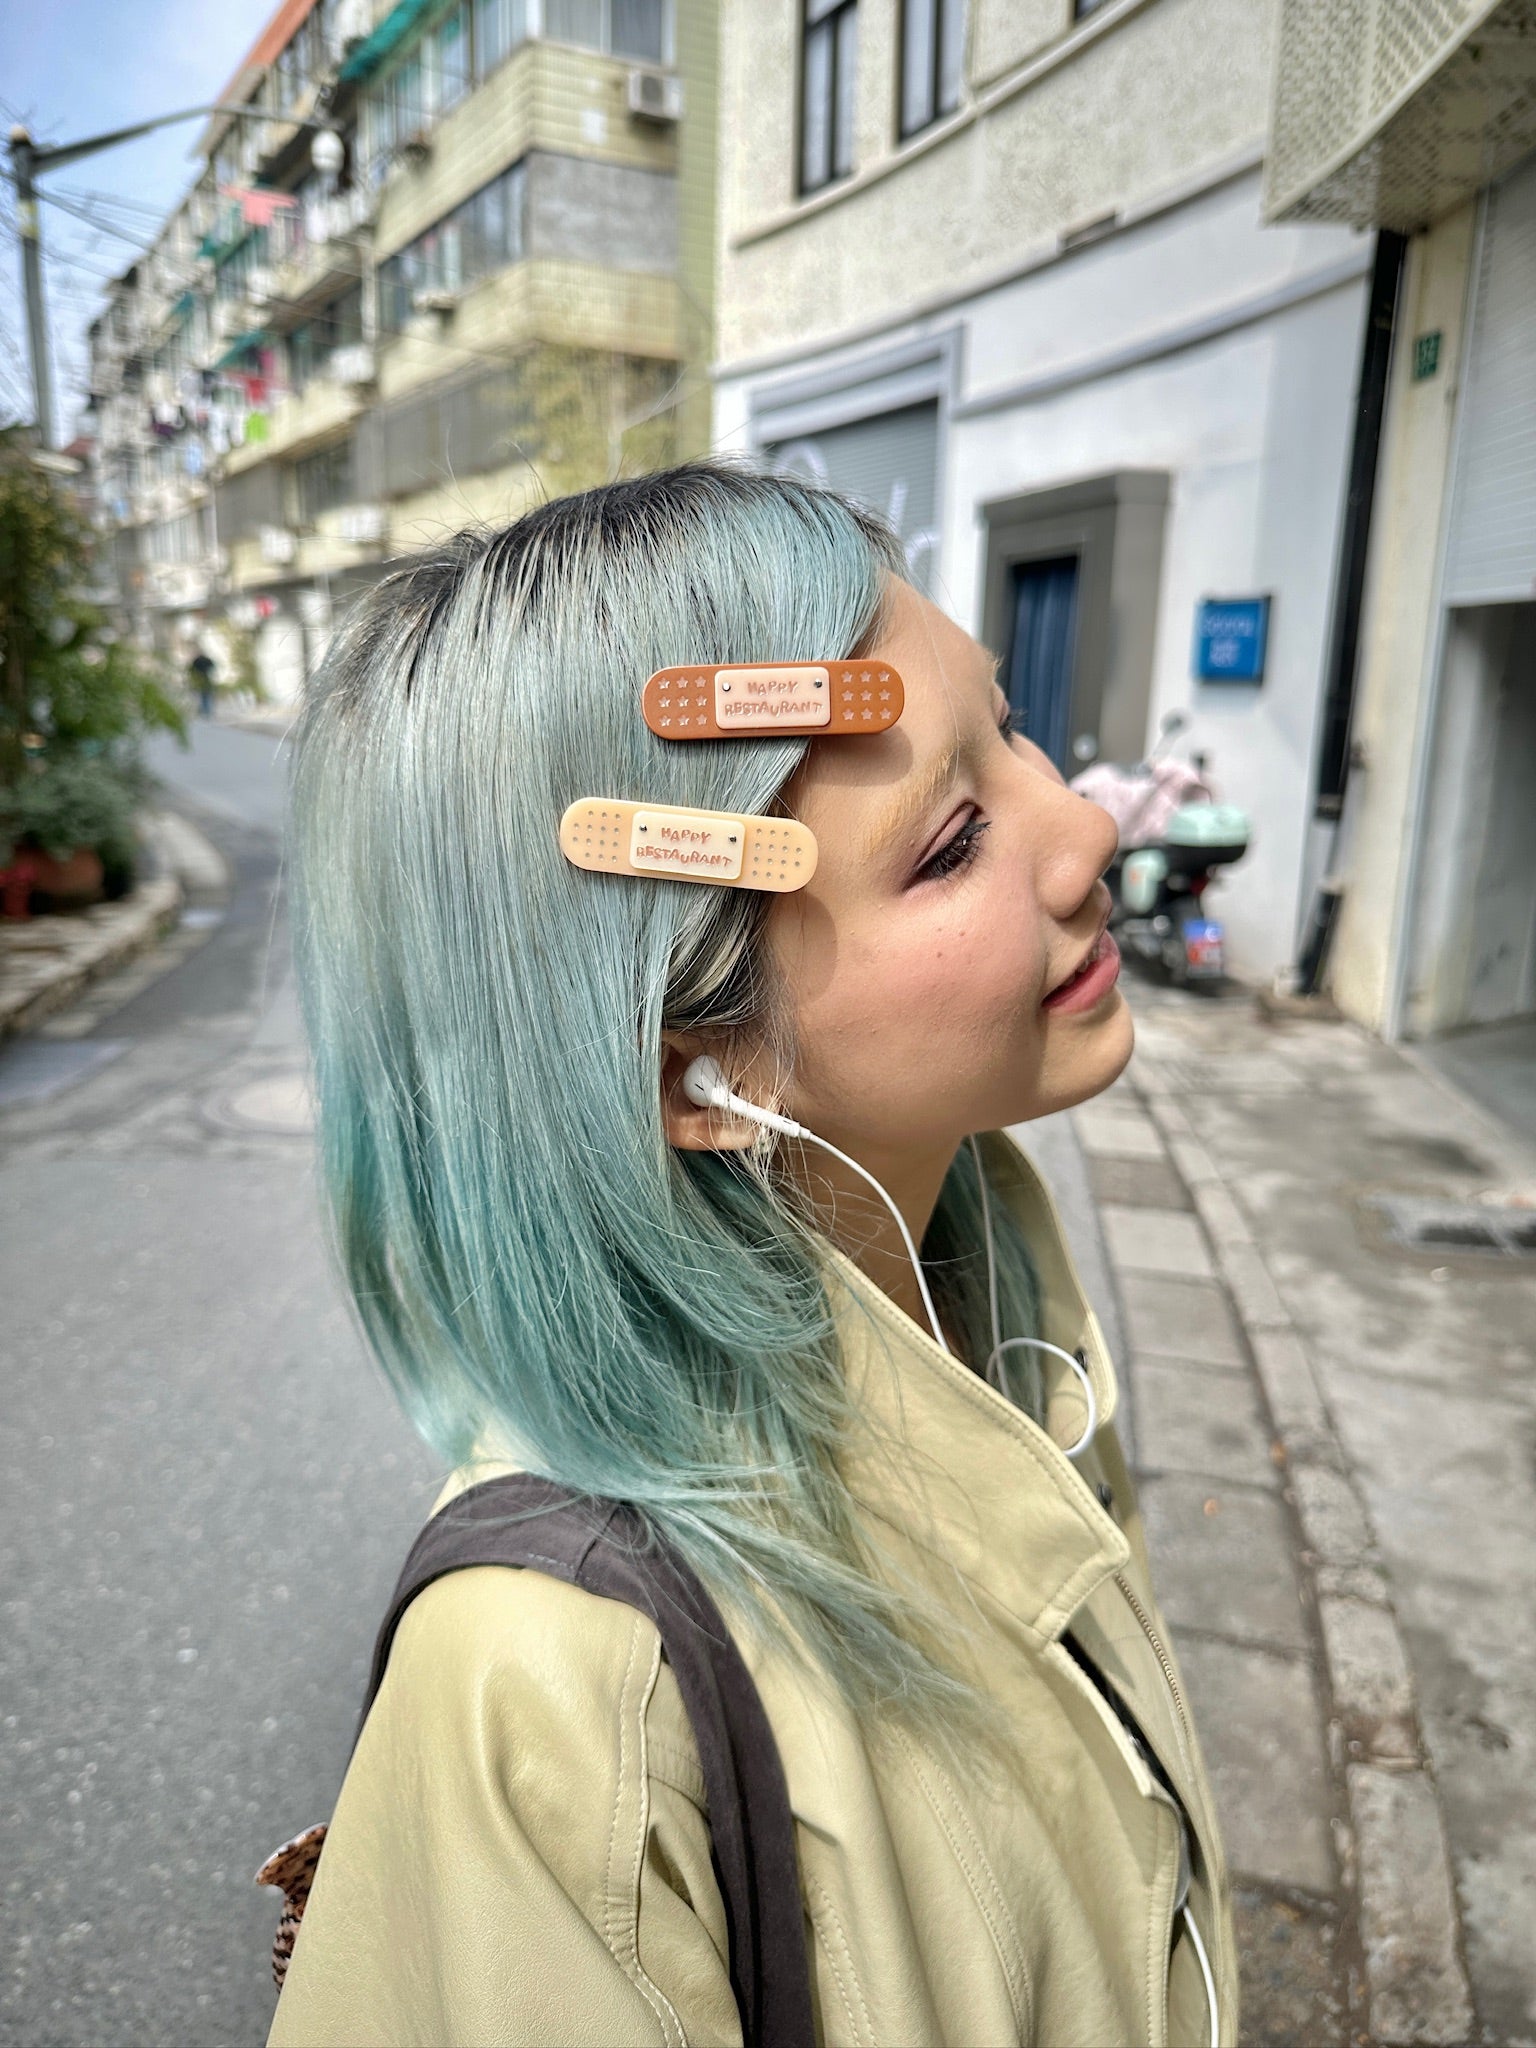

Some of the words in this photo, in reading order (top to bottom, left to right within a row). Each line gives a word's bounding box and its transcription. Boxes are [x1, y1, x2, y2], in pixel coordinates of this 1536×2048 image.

[747, 681, 798, 696] HAPPY
[724, 701, 823, 717] RESTAURANT
[661, 827, 711, 844] HAPPY
[636, 846, 732, 867] RESTAURANT
